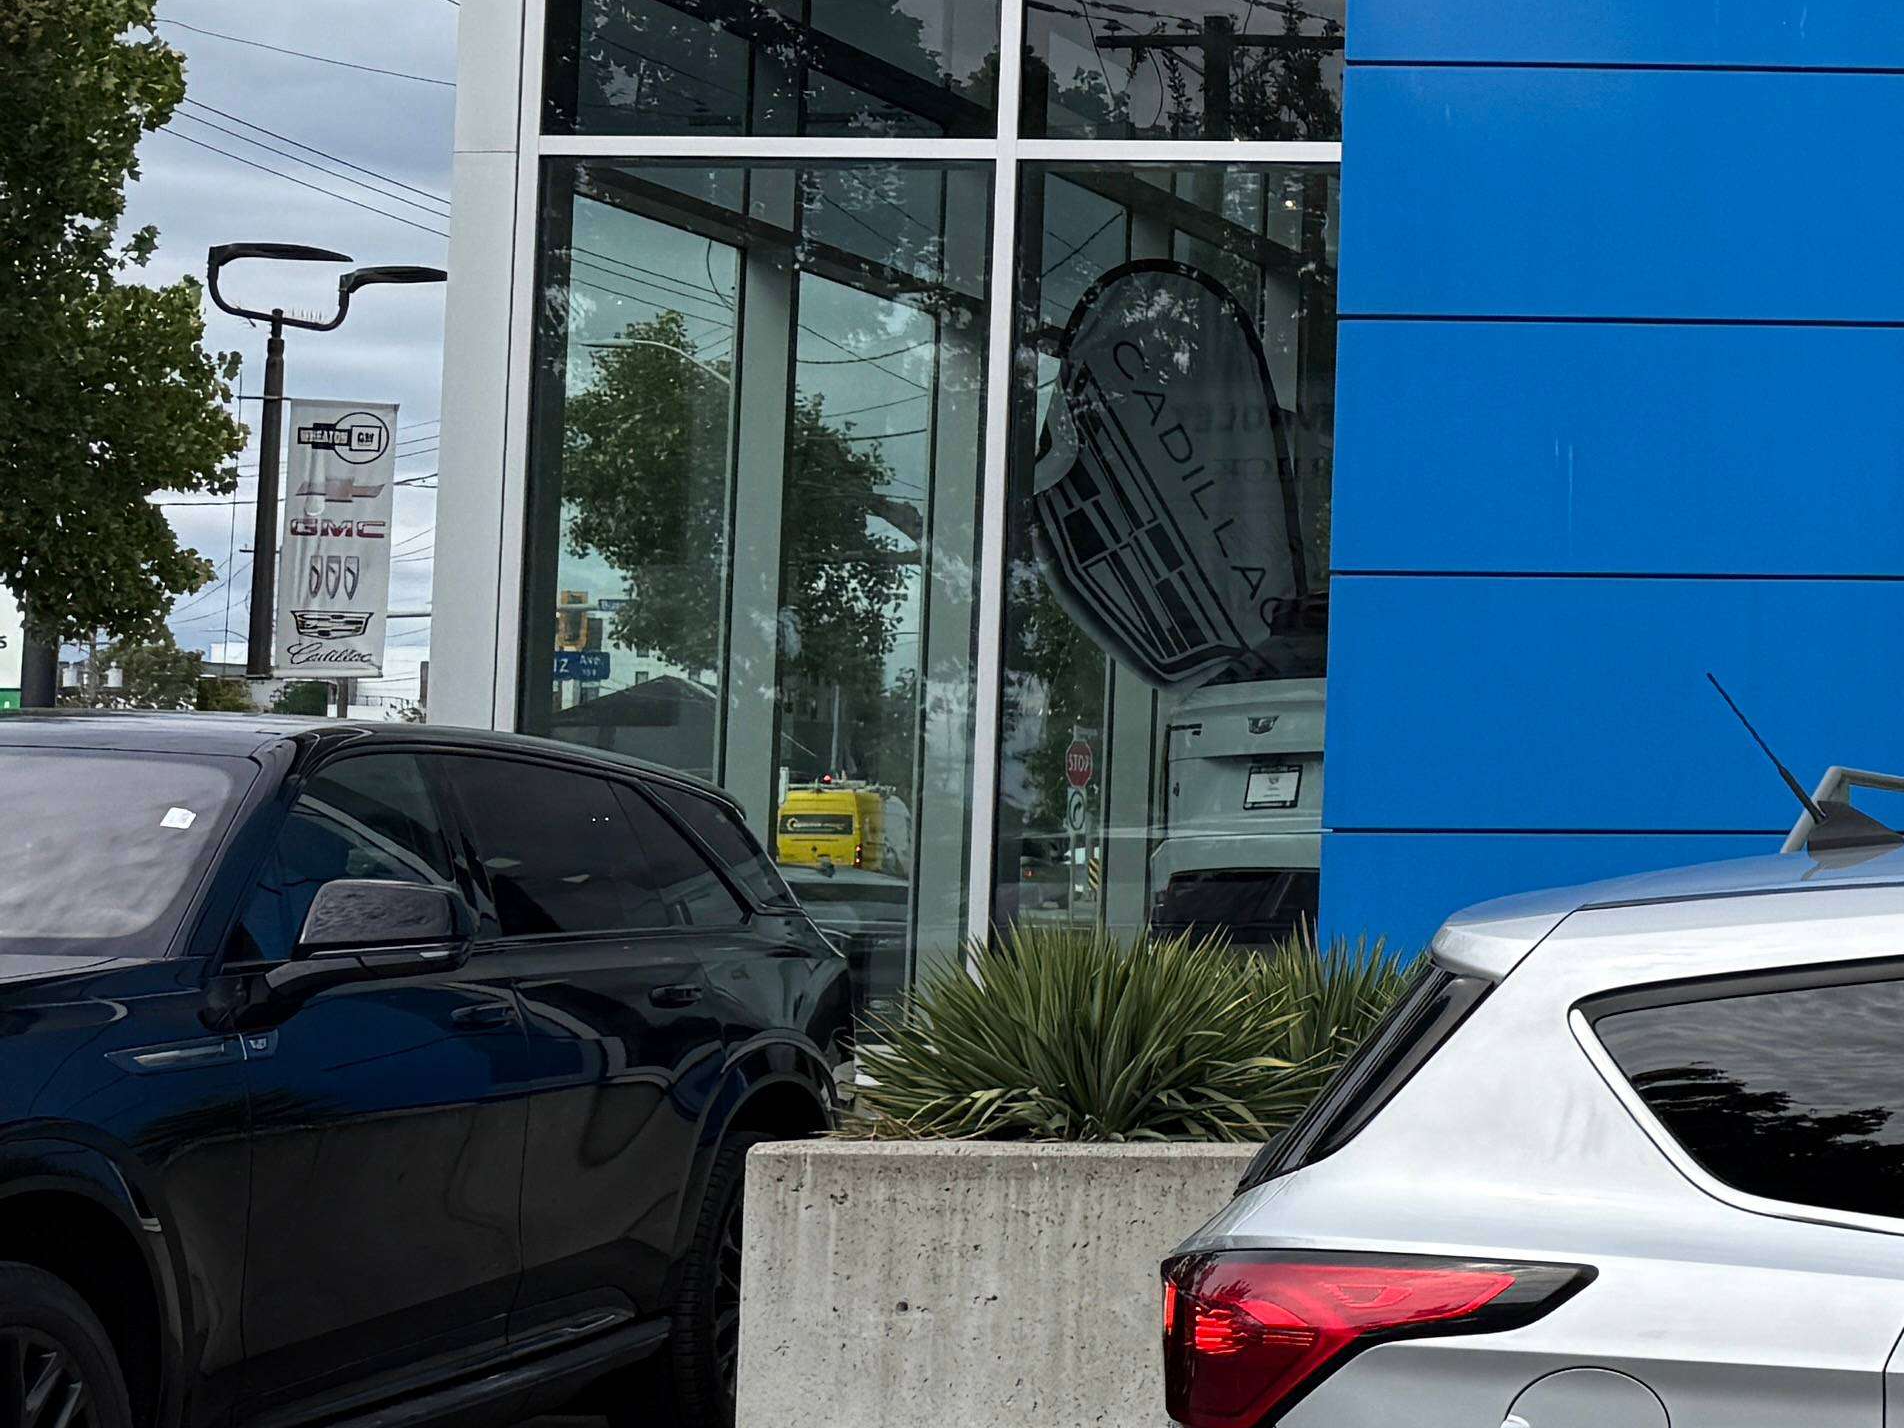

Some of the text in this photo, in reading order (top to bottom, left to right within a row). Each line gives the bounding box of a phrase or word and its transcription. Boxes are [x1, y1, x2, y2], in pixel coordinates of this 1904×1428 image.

[290, 518, 385, 538] GMC
[287, 642, 373, 665] Cadillac
[1068, 753, 1089, 772] STOP
